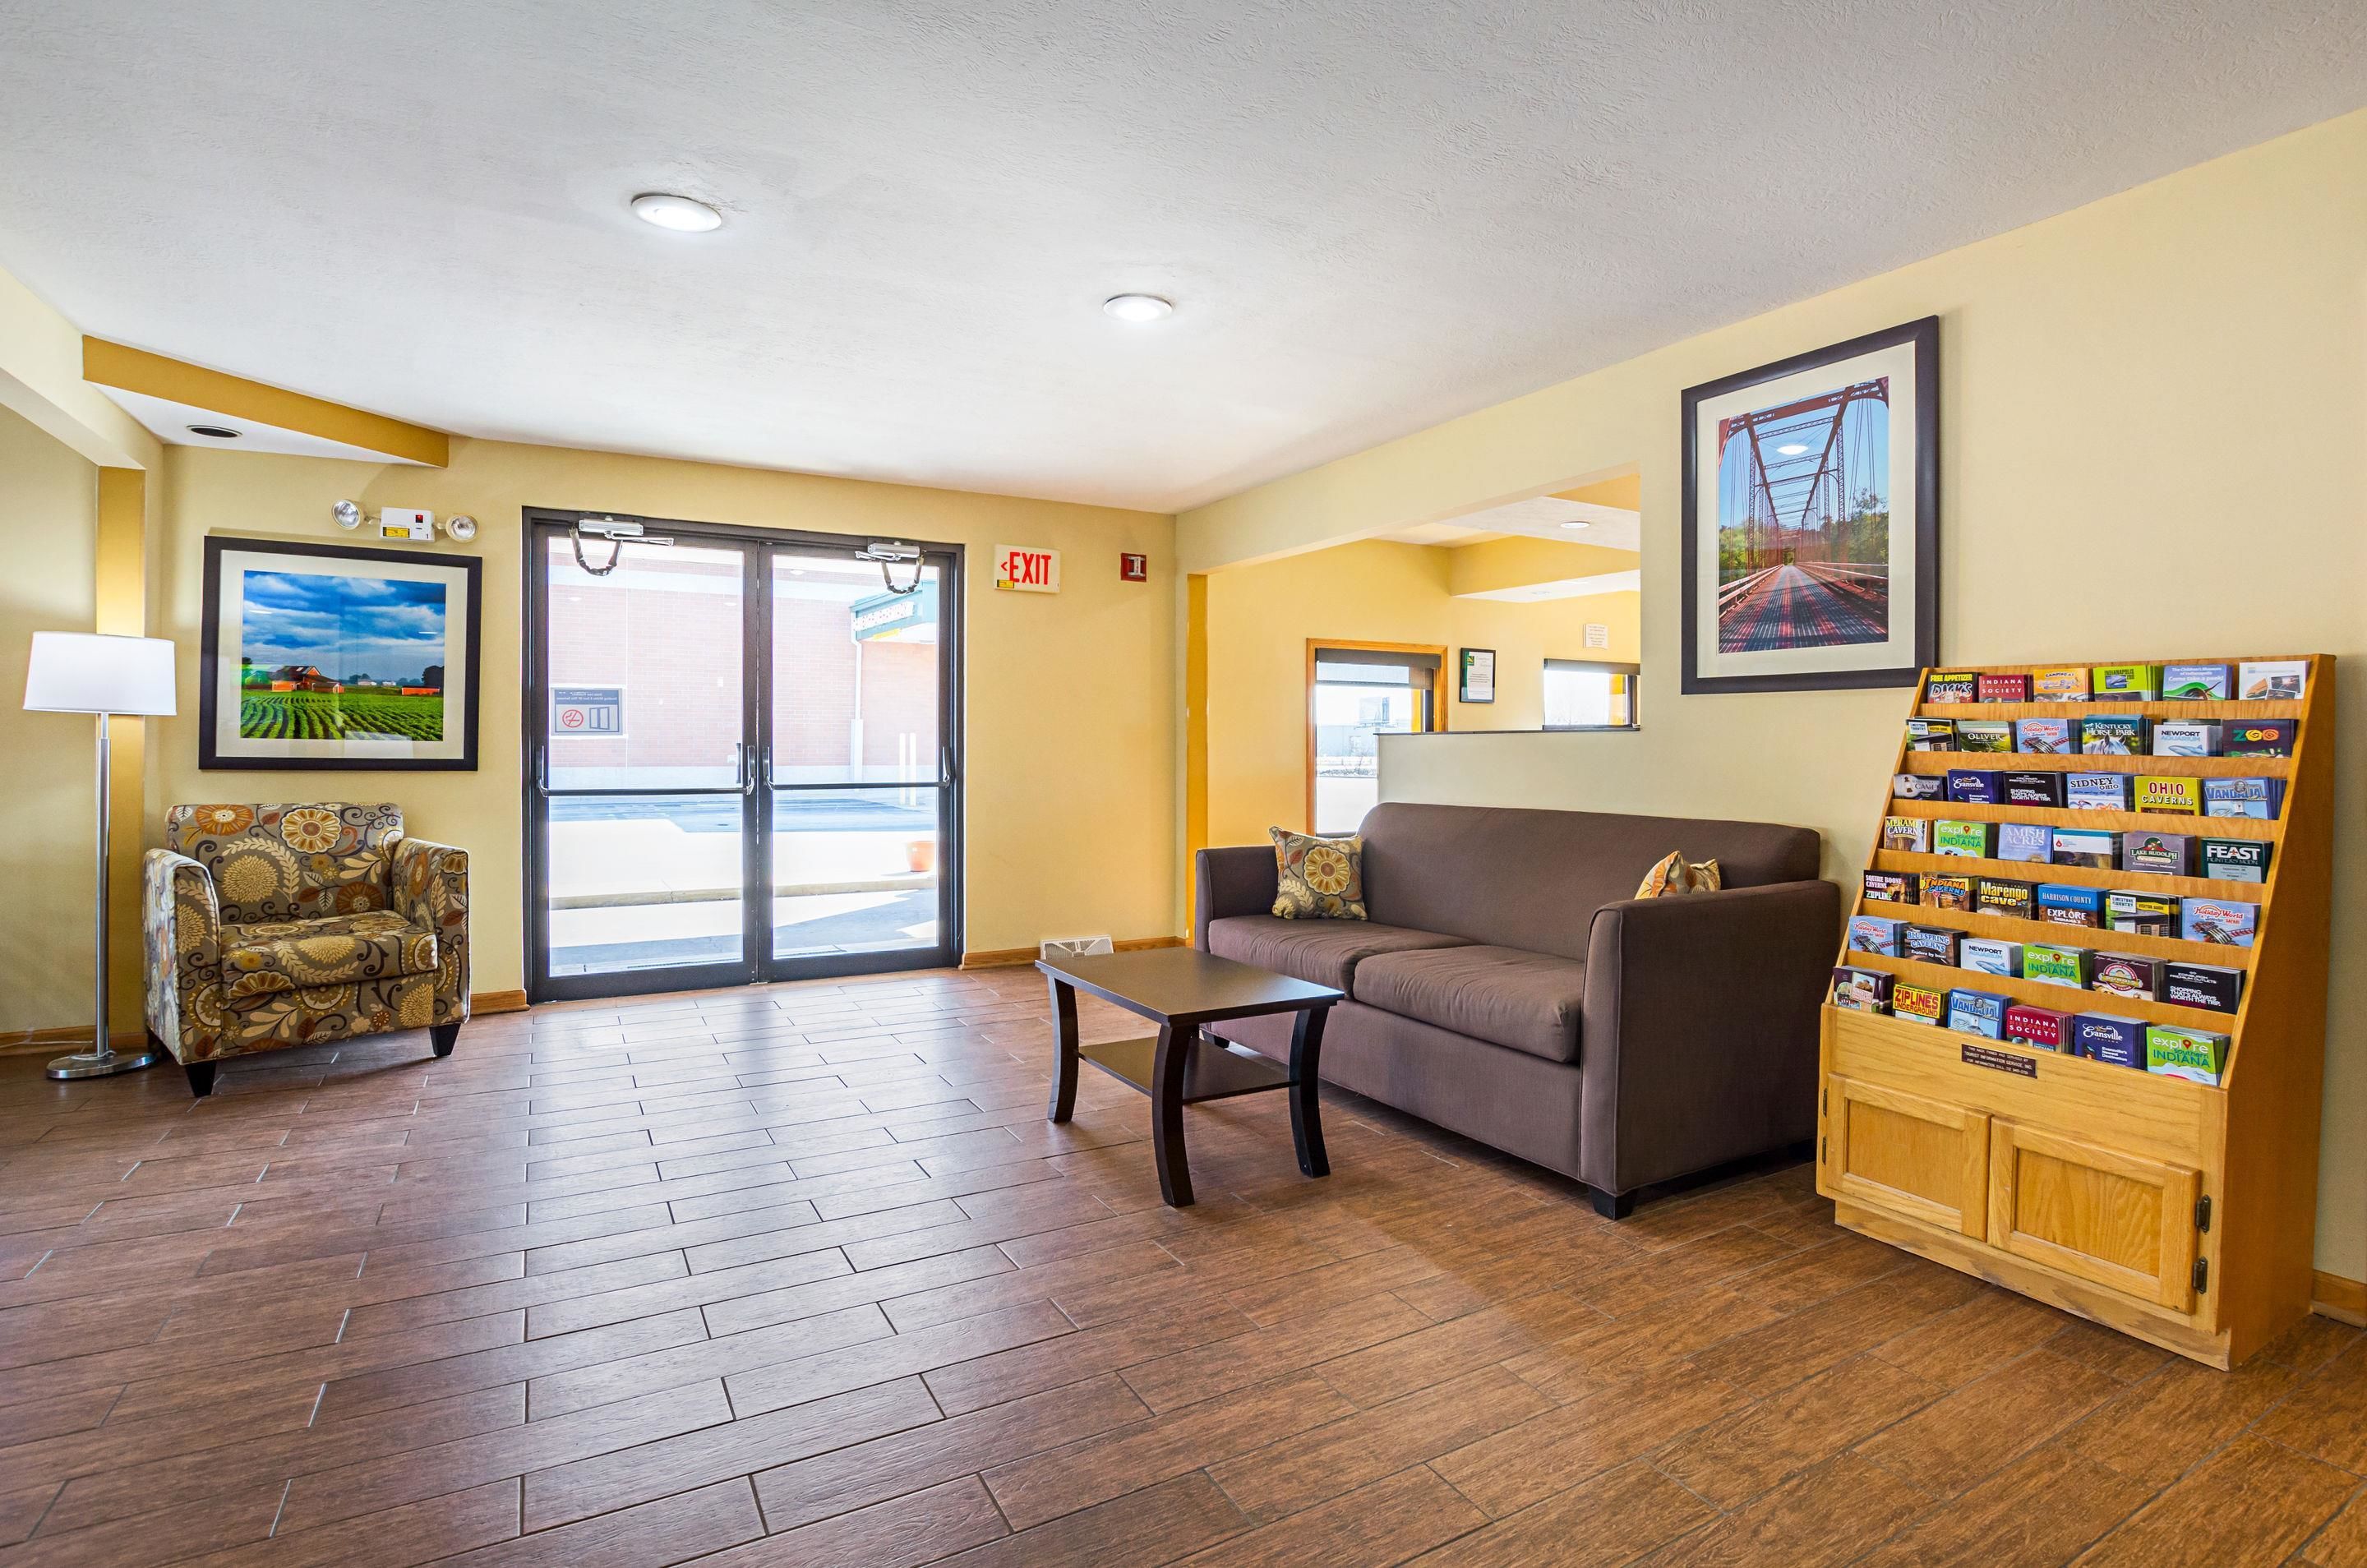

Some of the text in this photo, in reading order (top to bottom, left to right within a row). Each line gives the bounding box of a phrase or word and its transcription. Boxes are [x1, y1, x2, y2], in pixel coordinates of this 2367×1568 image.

[1009, 551, 1052, 586] EXIT
[1944, 673, 1972, 681] APPETIZER
[1931, 682, 1972, 698] DICK'S
[2023, 723, 2060, 734] Holiday World
[2086, 728, 2112, 736] HORSE
[1968, 732, 2005, 742] OLIVER
[2233, 729, 2280, 742] ZOO
[1953, 776, 1985, 789] Evansville
[2070, 777, 2114, 788] SIDNEY
[2149, 782, 2185, 796] OHIO
[2141, 795, 2194, 806] CAVERNS
[1887, 826, 1925, 837] CAVERNS
[1940, 824, 1982, 837] explore
[2005, 827, 2046, 838] AMISH
[1940, 836, 1982, 849] INDIANA
[2005, 836, 2045, 846] ACRES
[2148, 850, 2177, 860] RUDOLPH
[2206, 845, 2261, 860] FEAST
[1865, 874, 1903, 885] SQUIRE BOONE
[1866, 881, 1889, 889] CAVERNS
[1924, 876, 1967, 892] INDIANA
[1928, 886, 1966, 897] CAVERNS
[1980, 881, 2029, 902] Marengo
[1981, 895, 2018, 907] cave
[2042, 892, 2092, 905] HARRISON COUNTY
[2046, 907, 2088, 921] EXPLORE
[2054, 915, 2082, 924] INDIANA'S
[2194, 906, 2245, 920] Holiday World
[1874, 925, 1888, 934] World
[1905, 930, 1951, 945] BLUESPRING
[1911, 948, 1928, 957] Explore
[1913, 939, 1948, 953] CAVERNS
[1968, 944, 2004, 957] NEWPORT
[2027, 950, 2077, 966] explore
[2027, 962, 2078, 980] INDIANA
[2170, 985, 2203, 995] SHOPPING
[1894, 988, 1940, 1010] ZIPLINES
[2170, 994, 2194, 1002] WORTH
[2192, 992, 2217, 1002] ALWAYS
[1894, 1002, 1939, 1017] UNDERGROUND
[2010, 1014, 2058, 1029] INDIANA
[2009, 1024, 2058, 1039] SOCIETY
[2082, 1023, 2123, 1042] Evansville
[2102, 1046, 2128, 1055] Evansville's
[2153, 1036, 2209, 1057] explore
[2102, 1054, 2128, 1063] Destination
[2153, 1049, 2210, 1068] INDIANA
